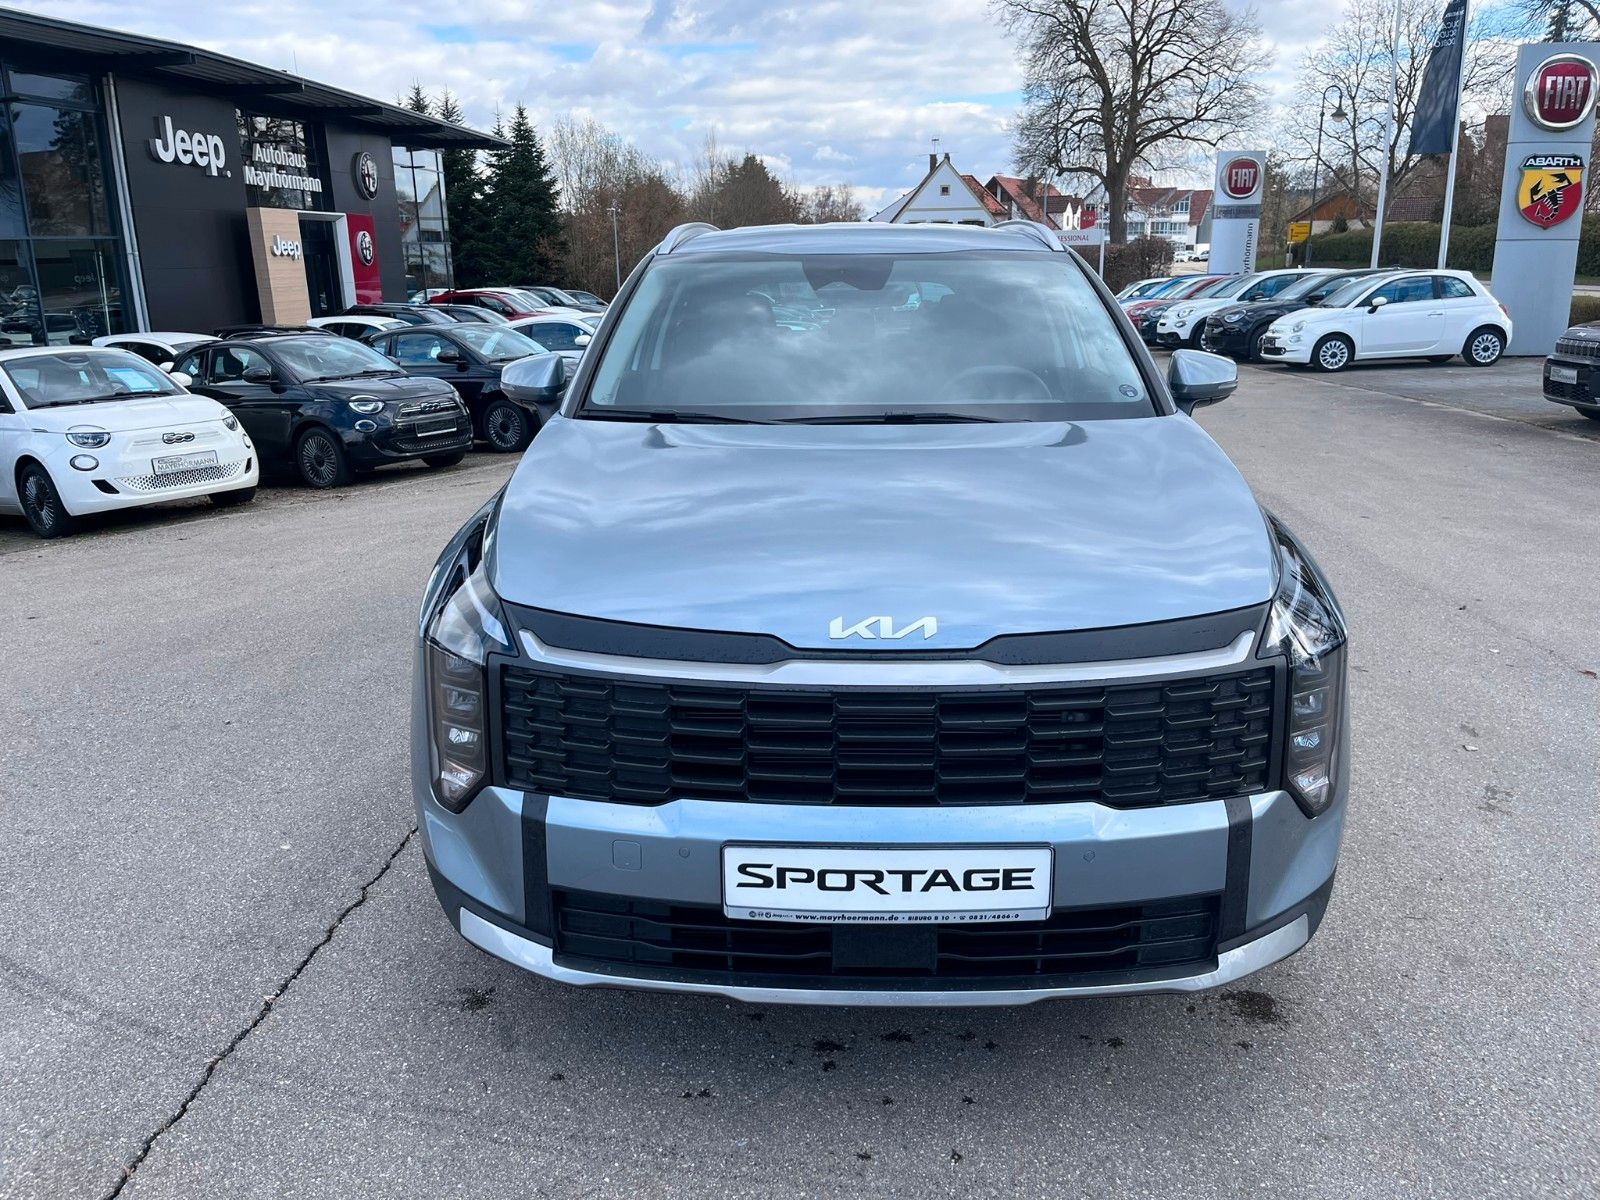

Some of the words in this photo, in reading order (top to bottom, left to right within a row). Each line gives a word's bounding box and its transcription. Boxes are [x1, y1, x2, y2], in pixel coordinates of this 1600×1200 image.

[1543, 76, 1588, 110] FIAT
[155, 115, 226, 177] Jeep
[253, 143, 307, 168] Autohaus
[1526, 156, 1581, 166] ABARTH
[243, 165, 322, 192] Mayrhörmann
[1231, 168, 1255, 188] FIAT
[273, 234, 301, 259] Jeep
[162, 432, 195, 444] 500
[829, 616, 938, 640] KIA
[736, 863, 1037, 895] SPORTAGE
[795, 913, 899, 921] www.mayrhoermann.de
